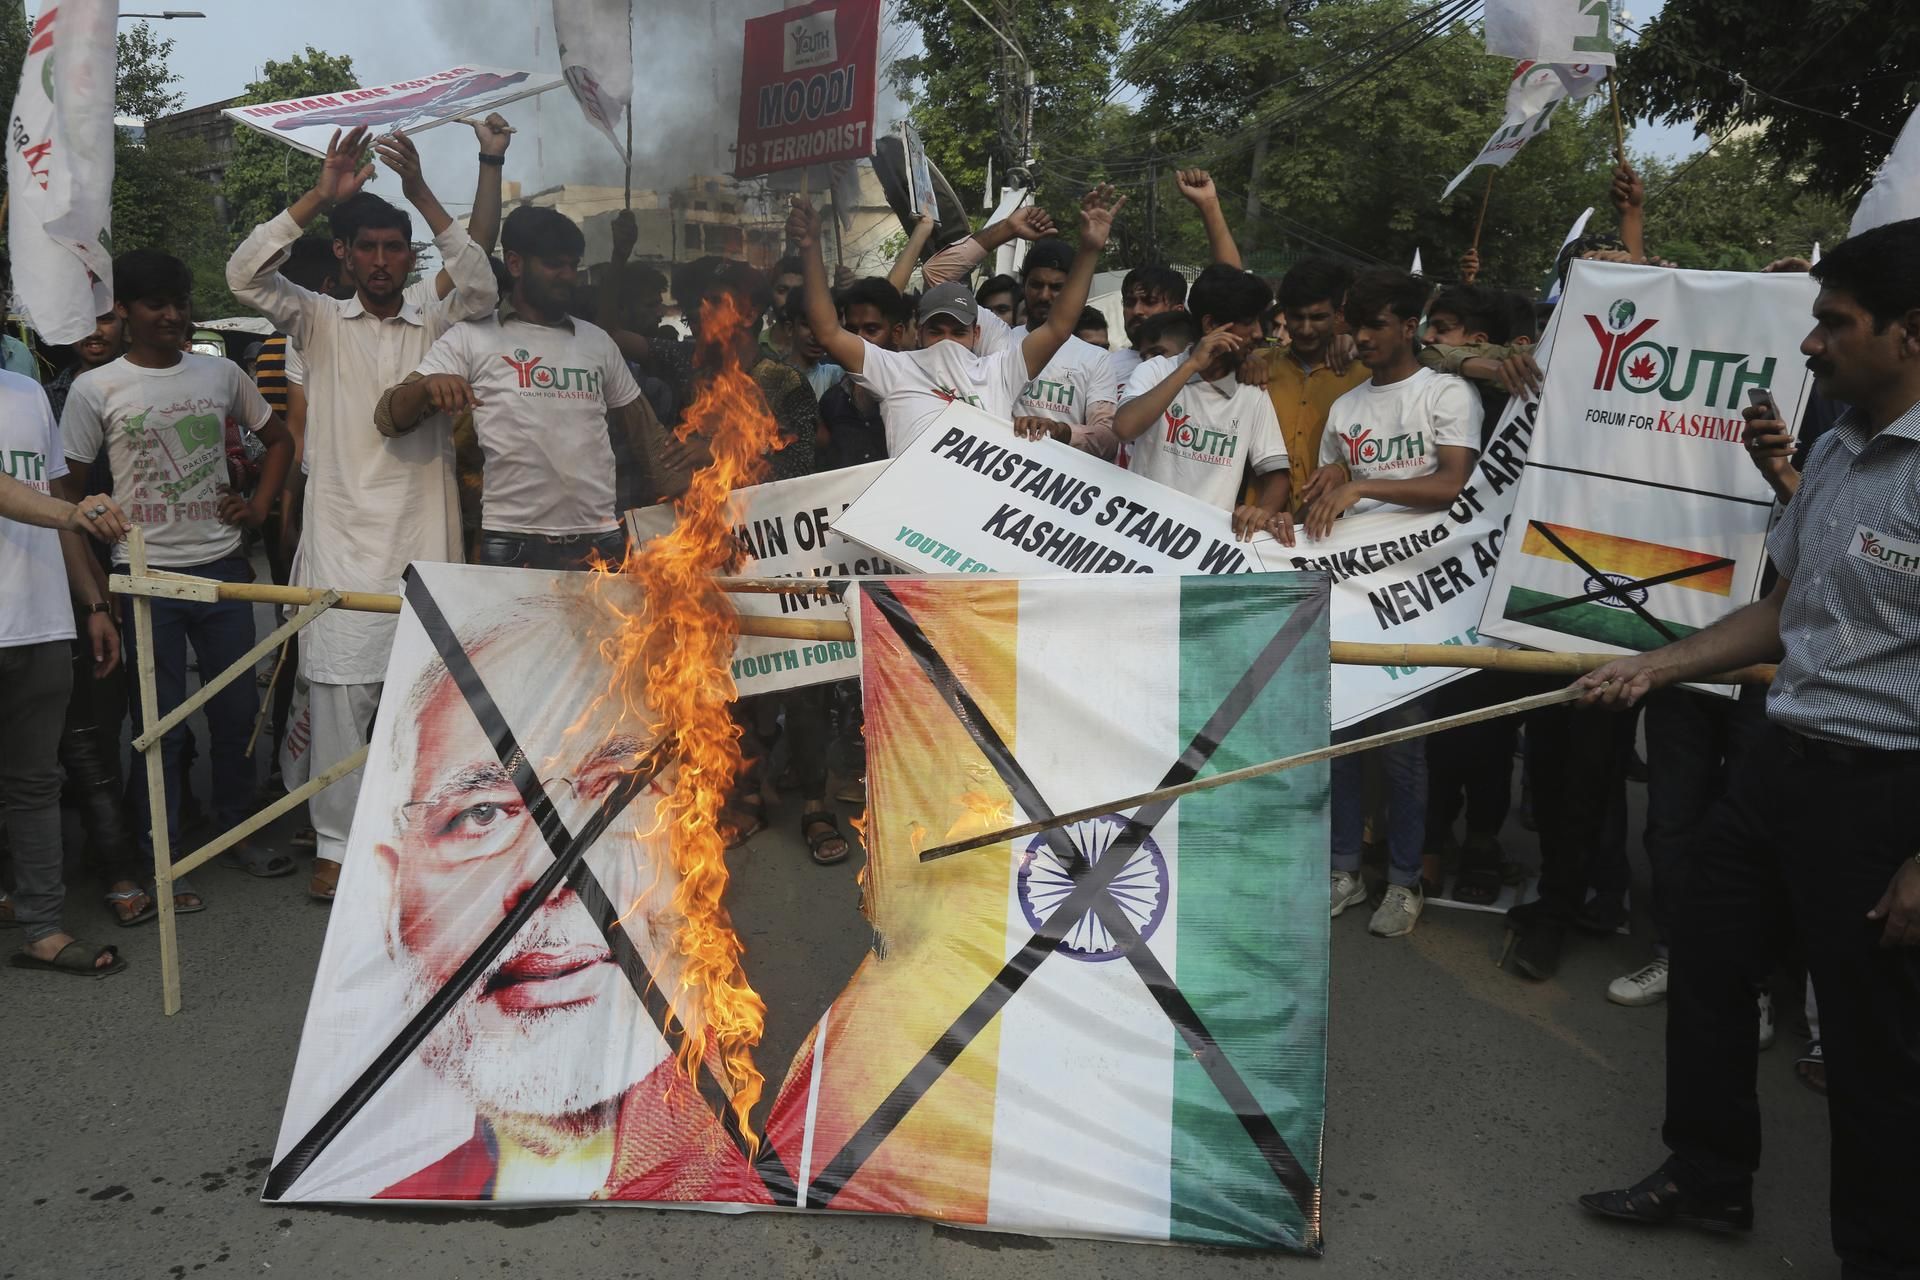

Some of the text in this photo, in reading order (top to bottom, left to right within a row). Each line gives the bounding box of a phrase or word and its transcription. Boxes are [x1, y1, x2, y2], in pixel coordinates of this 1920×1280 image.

[791, 28, 830, 56] YOUTH
[242, 96, 343, 118] INDIAN
[757, 63, 856, 129] MOODI
[740, 120, 867, 169] IS TERRIORIST
[501, 355, 599, 394] YOUTH
[1584, 314, 1777, 410] YOUTH
[1164, 410, 1237, 458] YOUTH
[1585, 408, 1627, 427] FORUM
[1627, 414, 1654, 431] FOR
[182, 446, 219, 472] PAKISTN
[1191, 451, 1233, 465] KASHMIR
[1339, 429, 1425, 465] YOUTH
[1378, 457, 1426, 472] KASHMIR
[1476, 398, 1539, 497] ARTIC
[129, 503, 168, 523] AIR
[931, 426, 1253, 575] PAKISTANIS STAND WI
[731, 515, 788, 561] AIN
[794, 507, 830, 551] OF
[894, 525, 962, 568] YOUTH
[1860, 532, 1920, 570] YOUTH
[1367, 555, 1475, 631] NEVER
[730, 651, 799, 680] YOUTH
